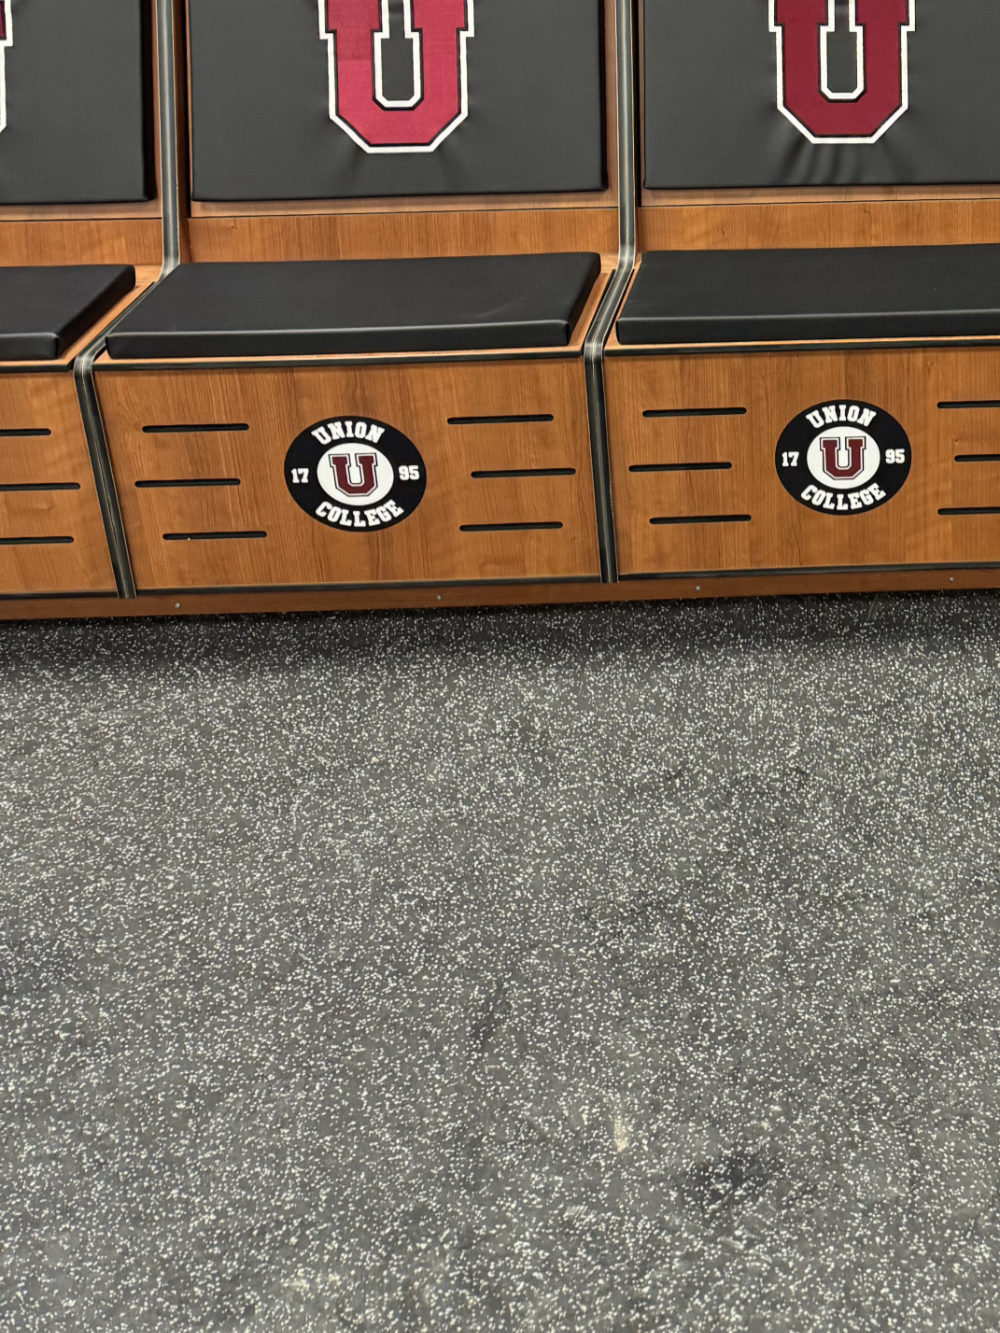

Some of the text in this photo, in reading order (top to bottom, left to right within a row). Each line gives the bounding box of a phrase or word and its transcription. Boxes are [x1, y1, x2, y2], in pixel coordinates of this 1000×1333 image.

[805, 404, 877, 429] UNION
[311, 420, 386, 445] UNION
[781, 448, 906, 467] 17 95
[820, 436, 867, 480] U
[290, 464, 420, 484] 17 95
[328, 453, 378, 497] U
[800, 482, 887, 511] COLLEGE
[315, 499, 405, 528] COLLEGE
